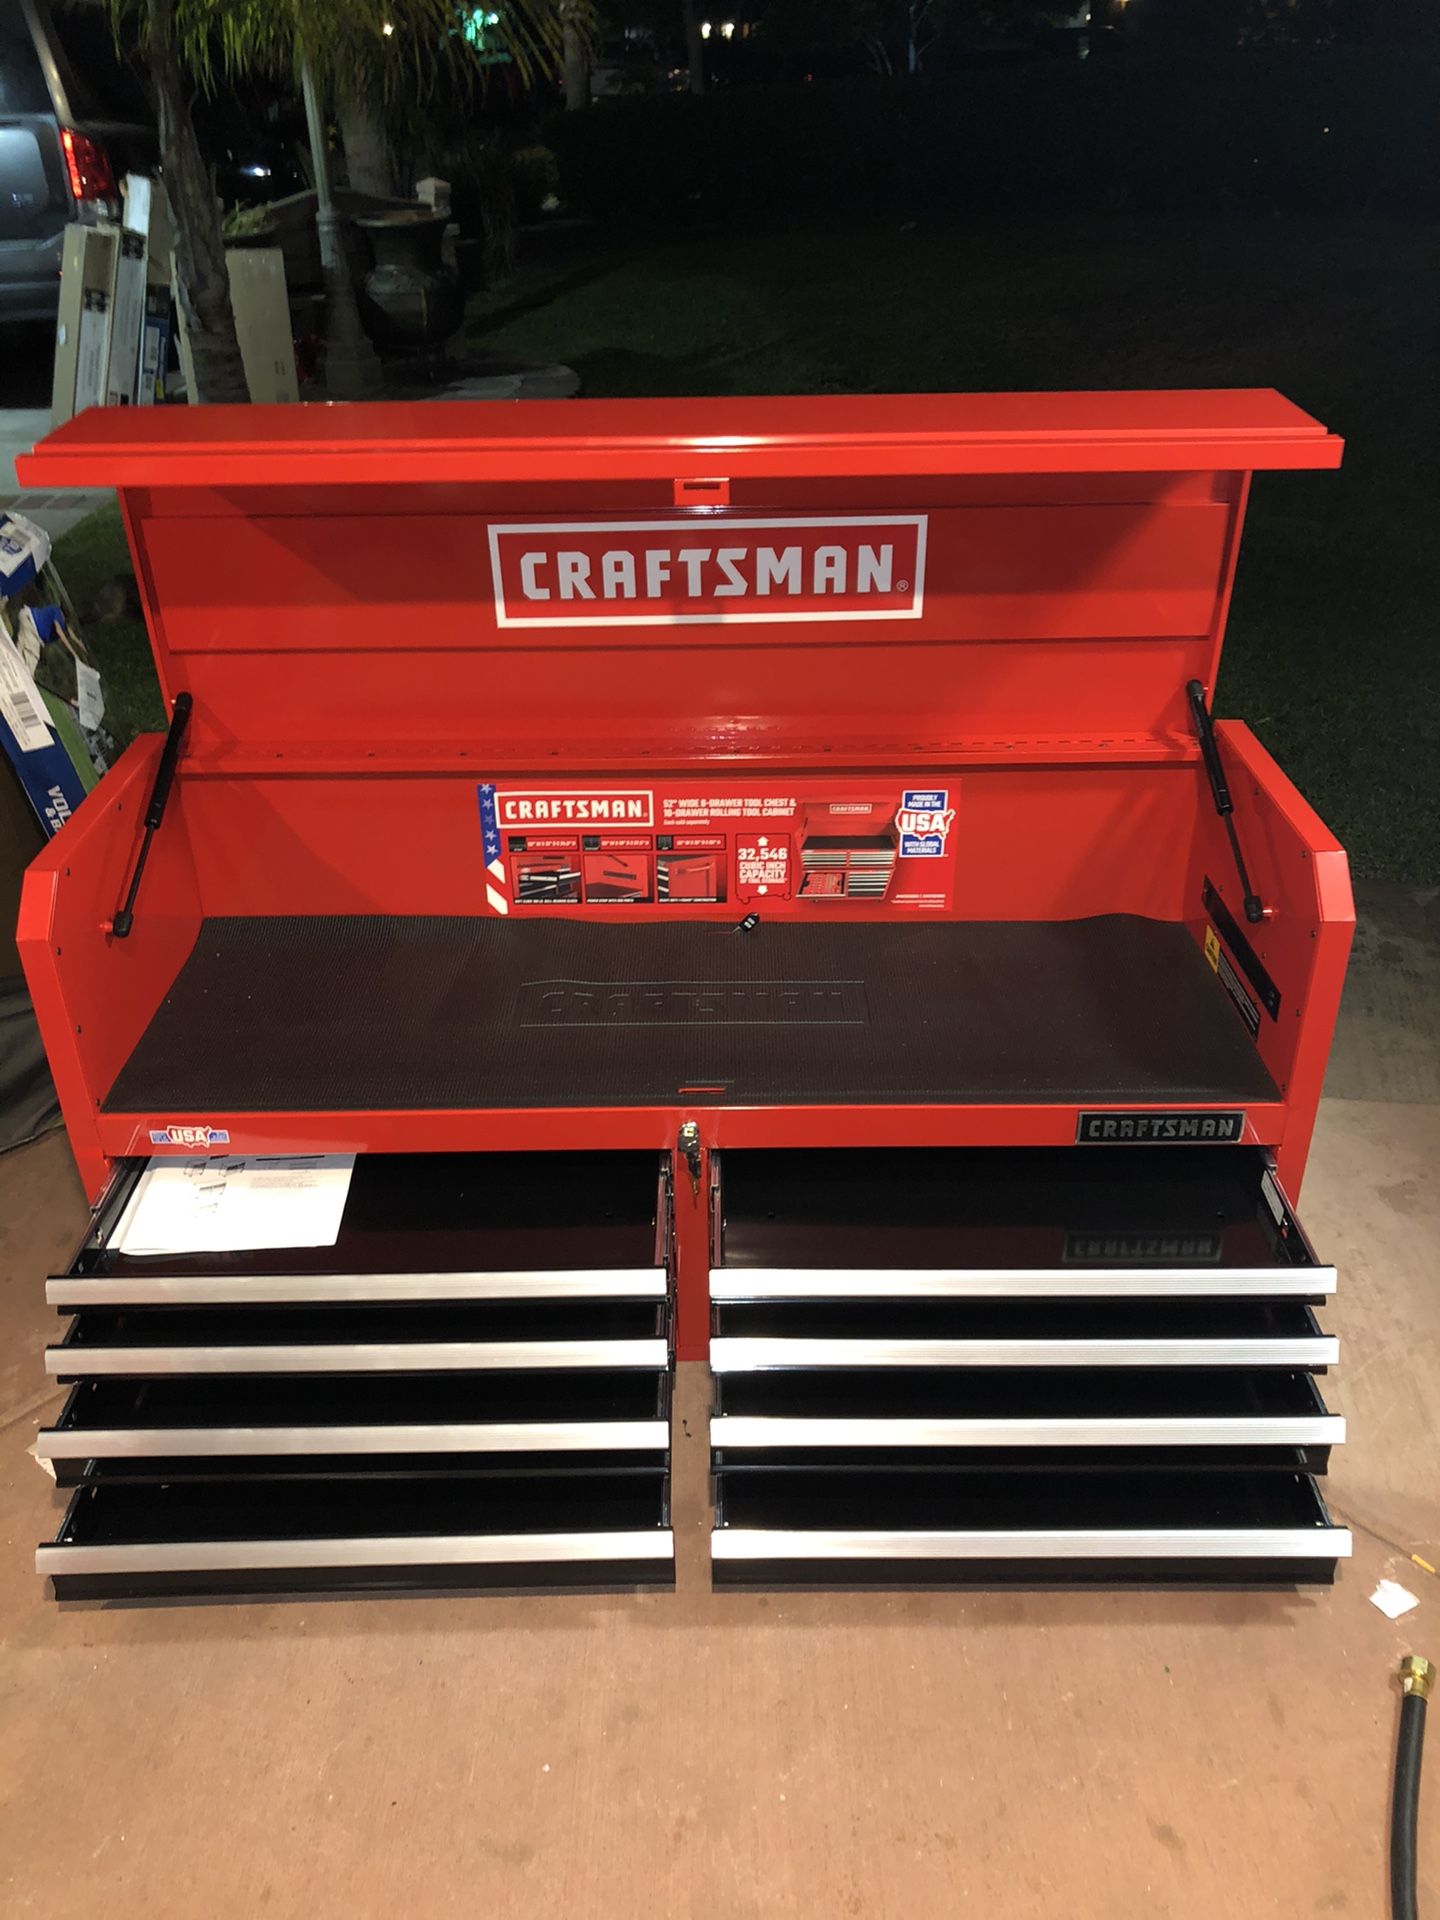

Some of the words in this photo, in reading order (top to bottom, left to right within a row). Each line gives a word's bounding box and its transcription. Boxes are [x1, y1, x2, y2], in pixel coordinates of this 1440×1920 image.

[520, 543, 894, 600] CRAFTSMAN
[505, 799, 643, 820] CRAFTSMAN
[678, 799, 700, 808] WIDE
[700, 798, 743, 808] 8-DRAWER
[744, 798, 763, 807] TOOL
[763, 798, 789, 807] CHEST
[789, 798, 797, 807] &
[663, 808, 709, 817] 10-DRAWER
[709, 808, 741, 817] ROLLING
[743, 807, 761, 816] TOOL
[762, 807, 795, 816] CABINET
[901, 813, 946, 832] USA
[737, 848, 788, 861] 32,546
[739, 861, 765, 869] CUBIC
[765, 861, 787, 869] INCH
[739, 869, 787, 878] CAPACITY
[1088, 1119, 1234, 1138] CRAFTSMAN
[171, 1129, 208, 1142] USA
